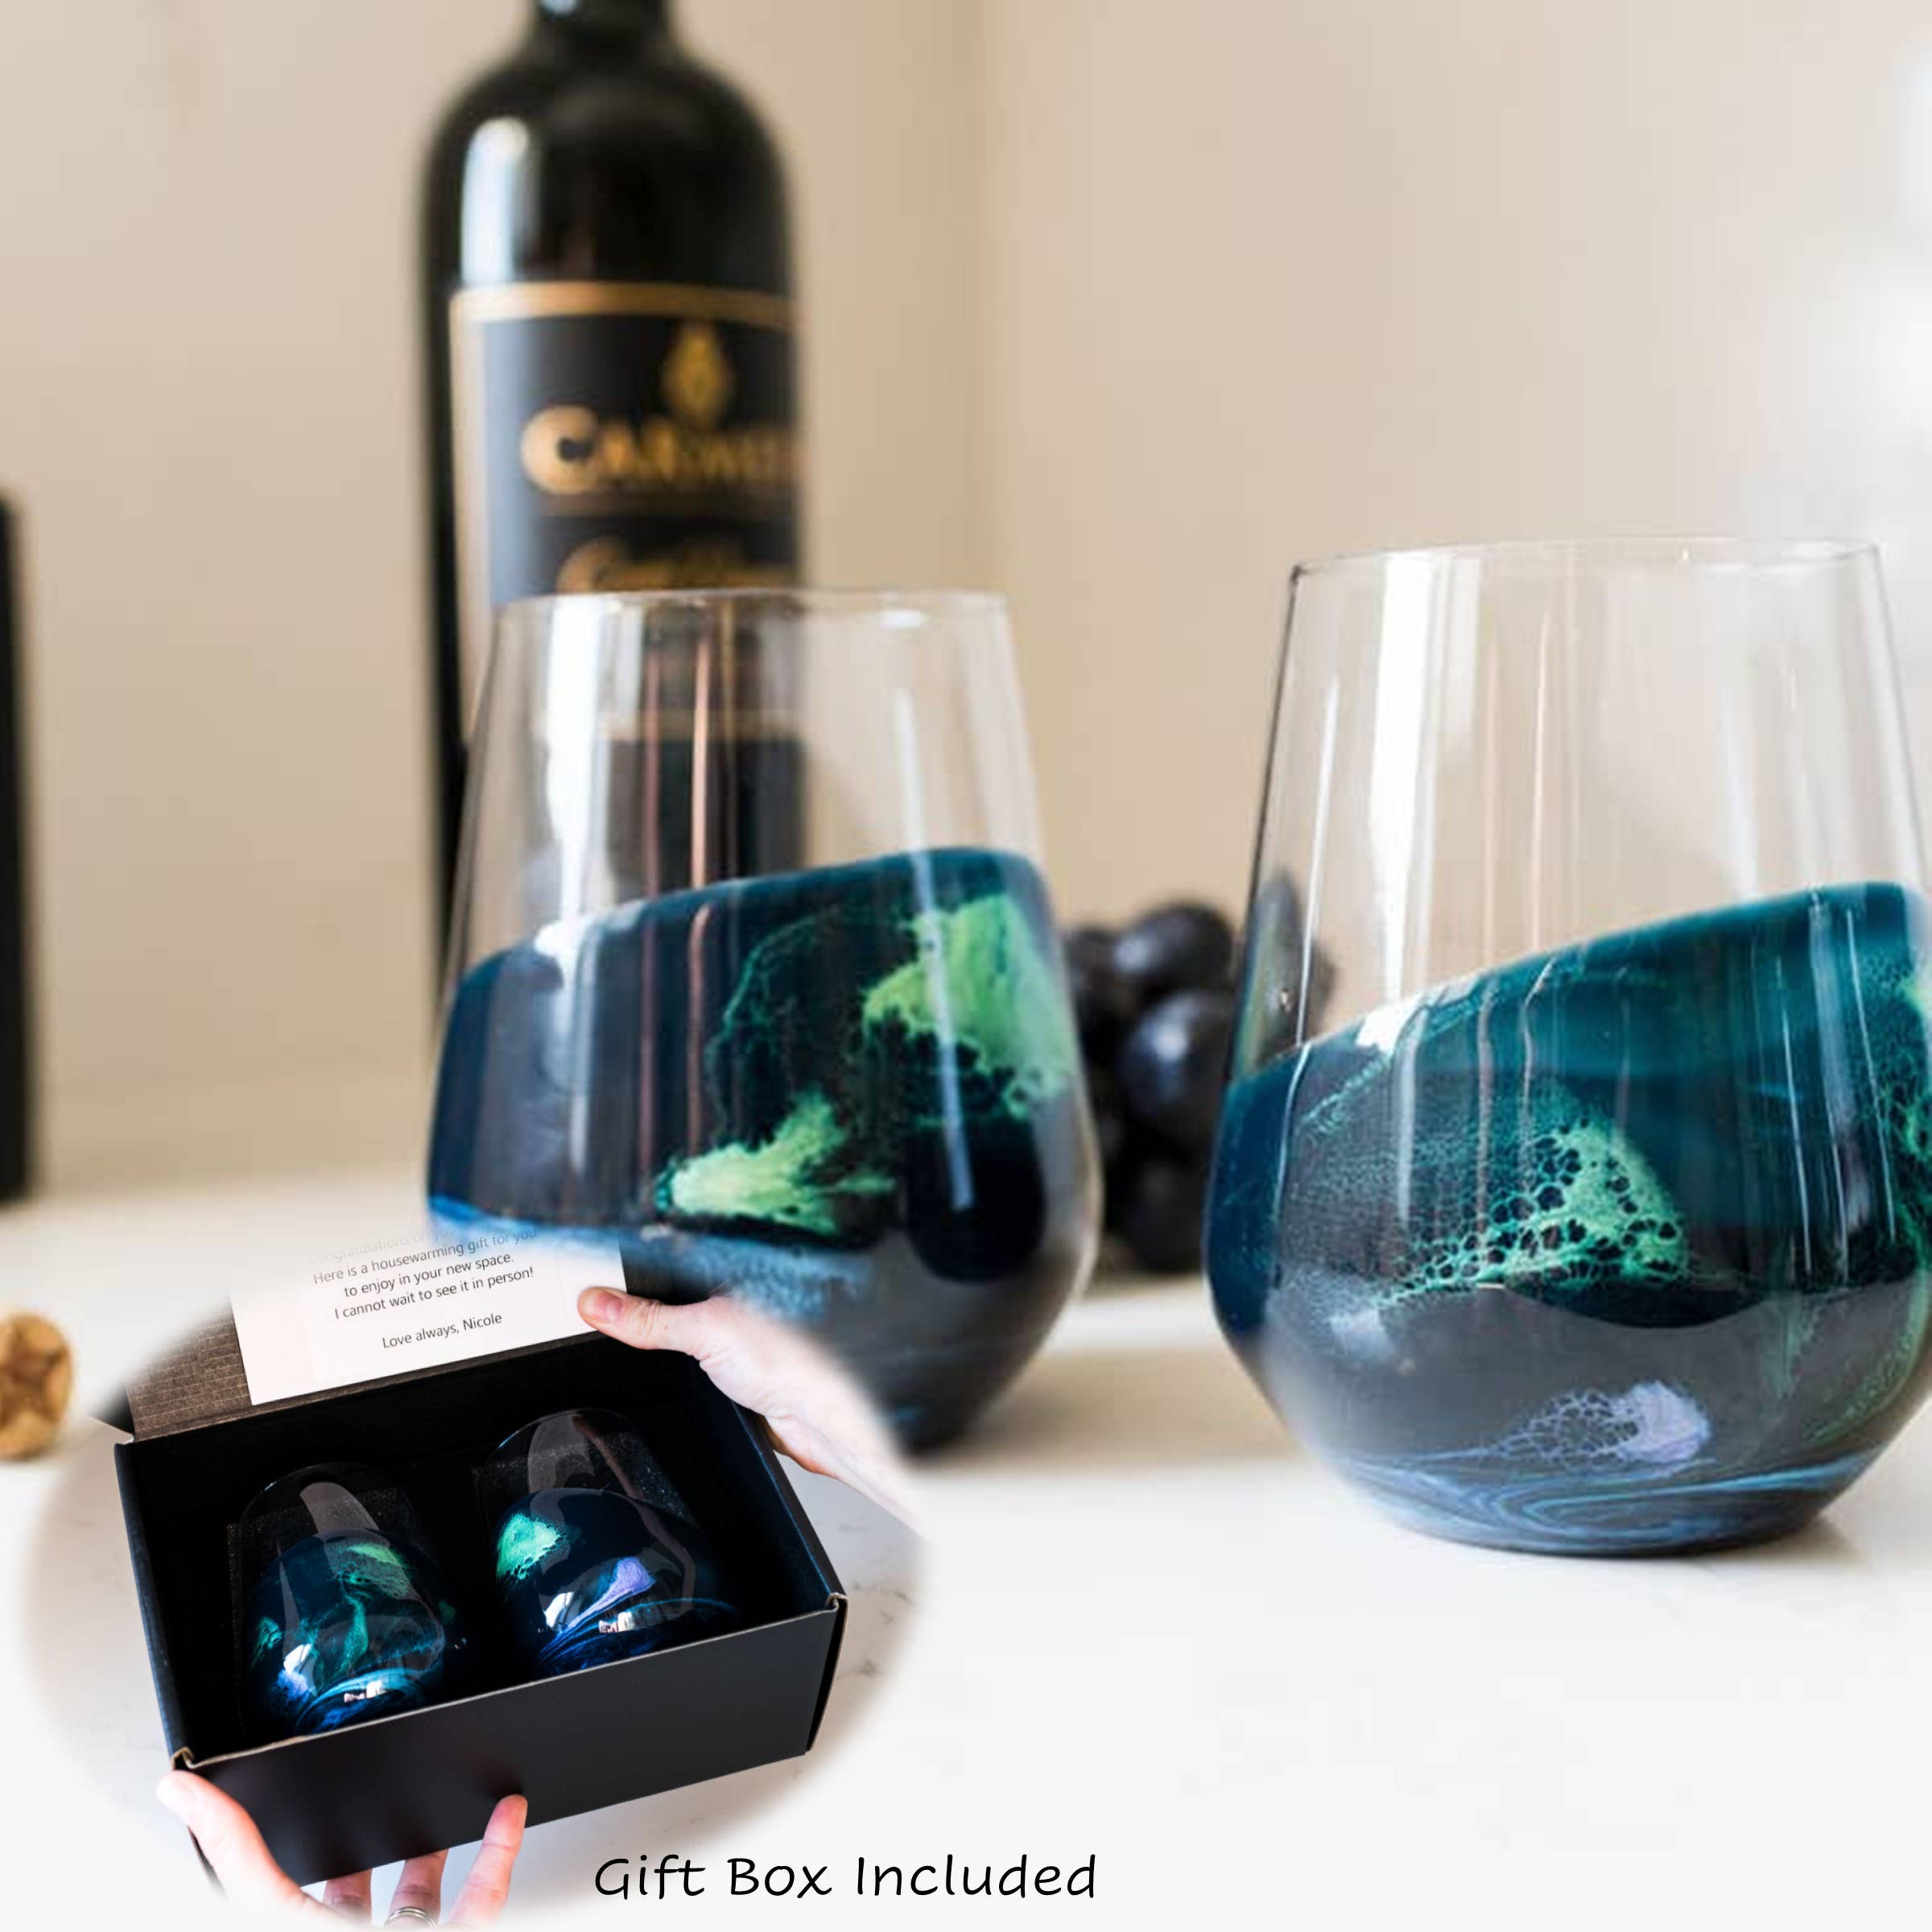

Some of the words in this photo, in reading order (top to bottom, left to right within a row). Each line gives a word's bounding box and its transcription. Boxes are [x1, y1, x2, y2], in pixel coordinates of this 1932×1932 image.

[313, 1269, 344, 1285] Here
[347, 1265, 357, 1277] is
[361, 1265, 369, 1274] a
[371, 1244, 464, 1272] housewarming
[468, 1237, 489, 1254] gift
[492, 1233, 510, 1246] for
[343, 1287, 358, 1298] to
[361, 1278, 395, 1294] enjoy
[398, 1274, 411, 1286] in
[414, 1268, 443, 1286] your
[445, 1262, 472, 1275] new
[475, 1253, 514, 1271] space.
[334, 1308, 340, 1319] I
[342, 1298, 387, 1319] cannot
[388, 1292, 416, 1307] wait
[418, 1290, 433, 1301] to
[435, 1285, 458, 1298] see
[460, 1280, 470, 1292] it
[472, 1278, 484, 1290] in
[487, 1265, 534, 1290] person!
[382, 1334, 413, 1349] Love
[415, 1324, 460, 1340] always,
[462, 1313, 503, 1331] Nicole
